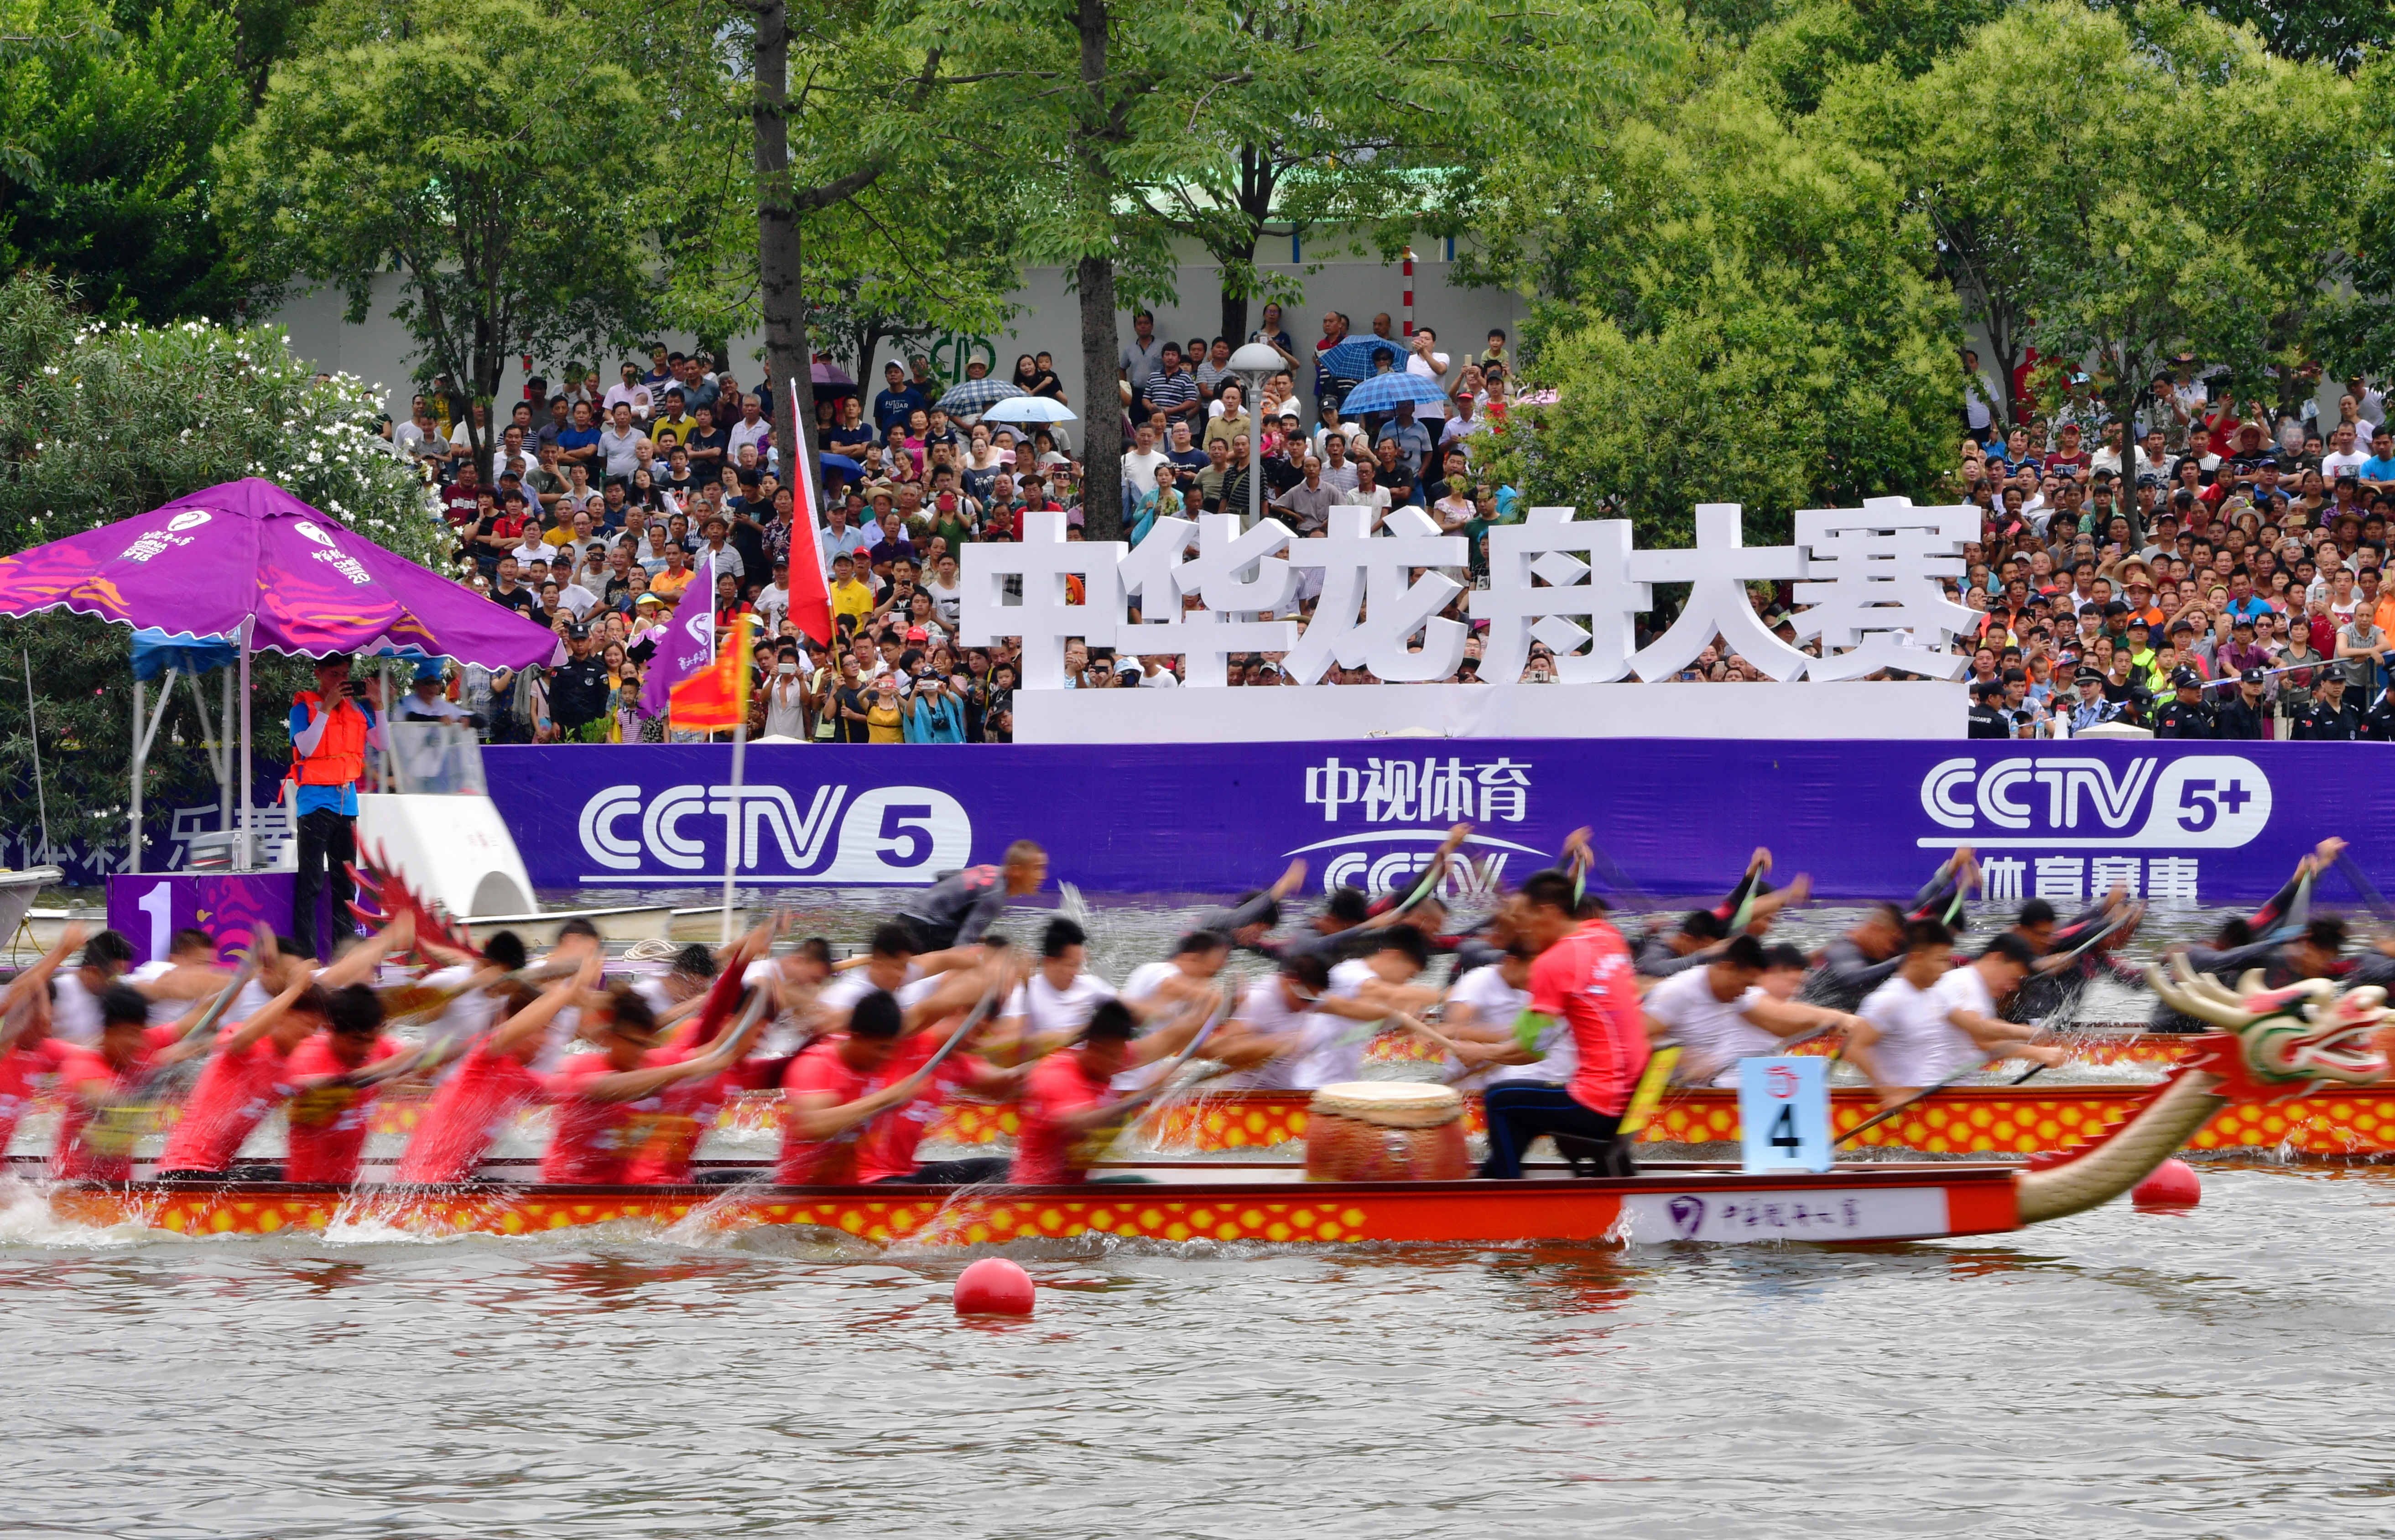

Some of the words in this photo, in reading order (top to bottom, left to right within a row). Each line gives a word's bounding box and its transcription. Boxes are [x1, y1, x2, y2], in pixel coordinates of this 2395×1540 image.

[960, 496, 1984, 688] 中华龙舟大赛
[1305, 757, 1532, 821] 中视体育
[1921, 757, 2158, 828] CCTV
[579, 785, 848, 869] CCTV
[139, 882, 171, 962] 1
[1765, 1103, 1806, 1158] 4
